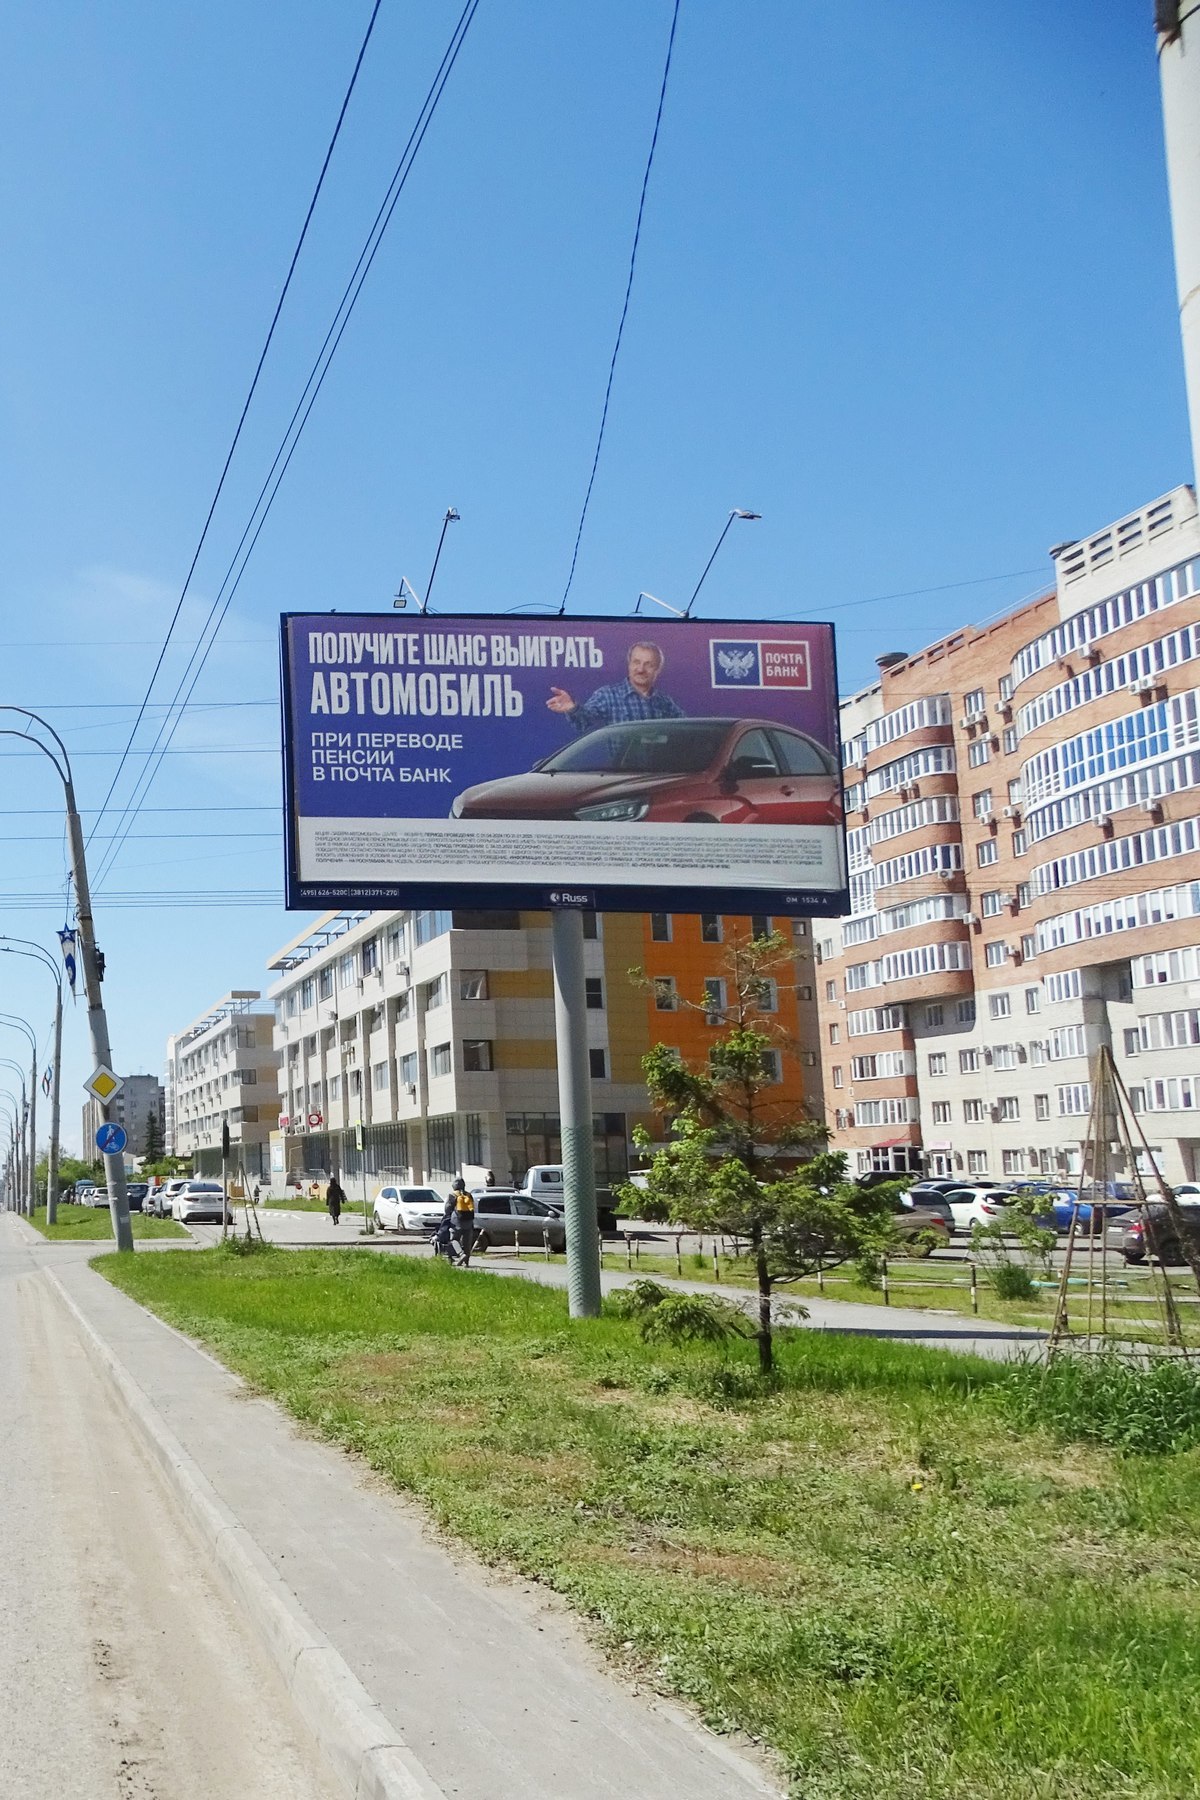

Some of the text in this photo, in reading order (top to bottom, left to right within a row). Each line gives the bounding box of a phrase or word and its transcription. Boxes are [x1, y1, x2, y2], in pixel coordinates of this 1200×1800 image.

[308, 632, 604, 668] ПОЛУЧИТЕ ШАНС ВЫИГРАТЬ
[765, 652, 803, 664] ПОЧТА
[766, 665, 799, 677] БАНК
[310, 671, 523, 717] АВТОМОБИЛЬ
[311, 732, 463, 751] ПРИ ПЕРЕВОДЕ
[311, 749, 394, 765] ПЕНСИИ
[312, 766, 452, 783] В ПОЧТА БАНК
[562, 893, 588, 903] Russ
